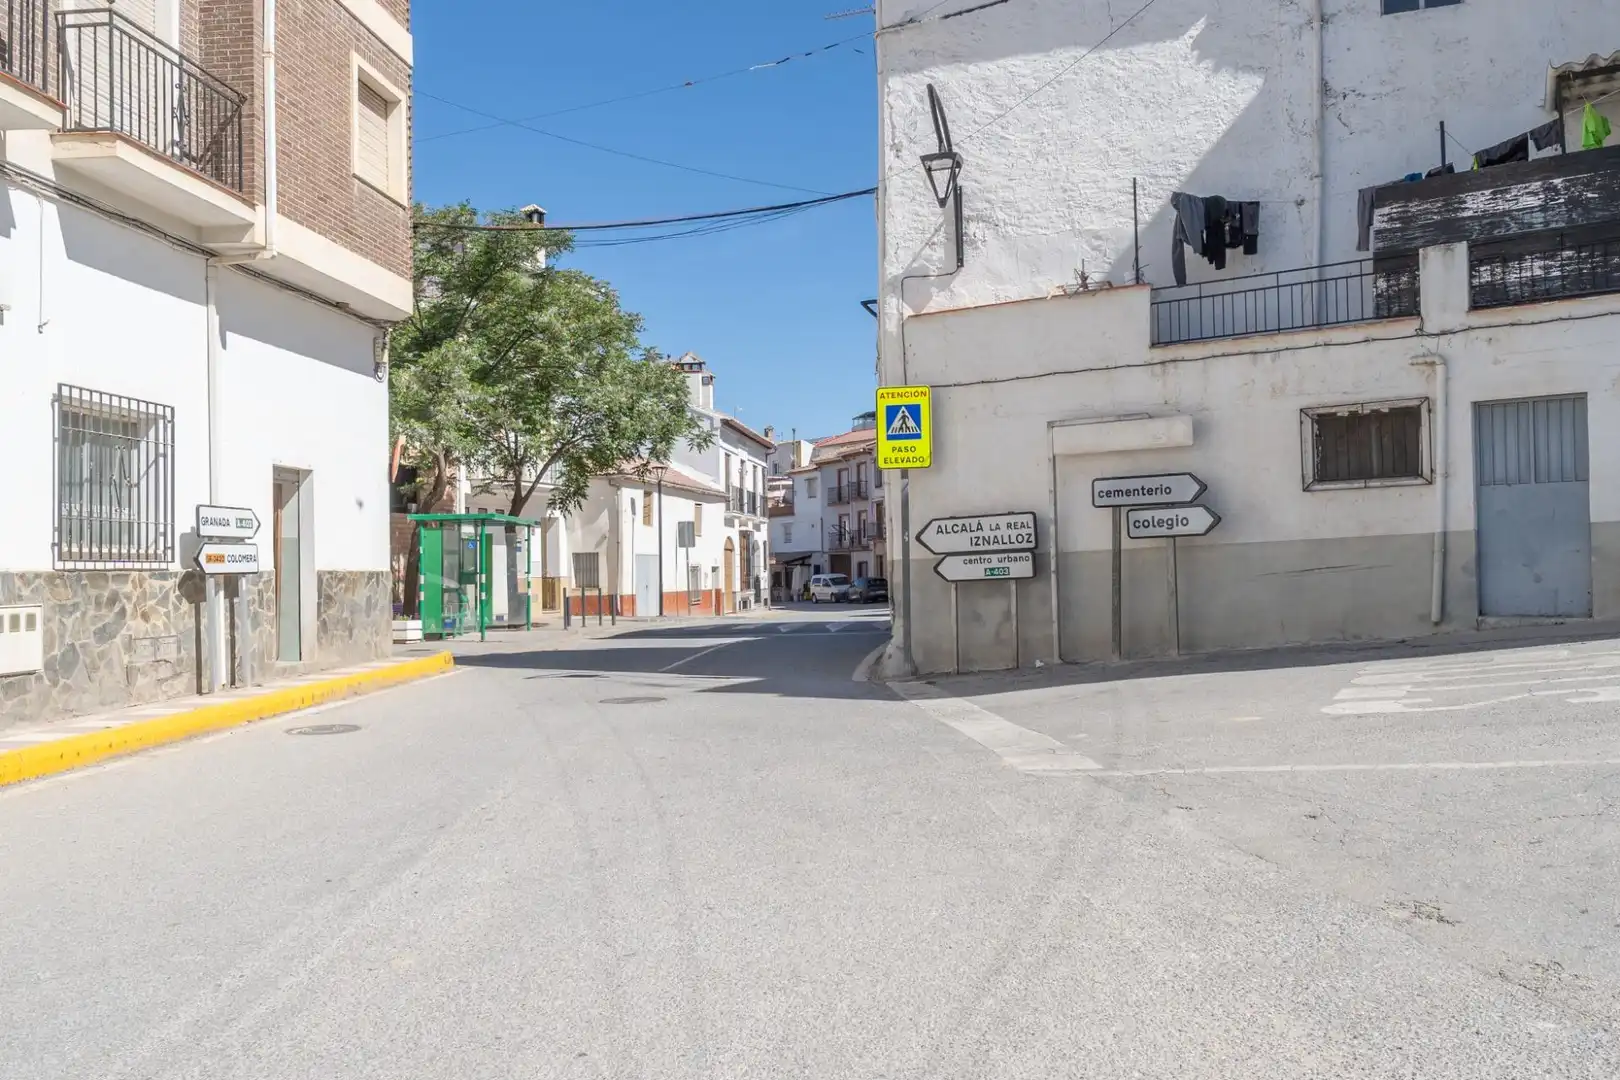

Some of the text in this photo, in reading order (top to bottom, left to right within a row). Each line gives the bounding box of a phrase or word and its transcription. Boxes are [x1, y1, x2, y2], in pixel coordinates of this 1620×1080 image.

[879, 390, 927, 399] ATENCIÓN
[883, 456, 925, 464] ELEVADO
[1097, 484, 1172, 499] cementerio
[201, 516, 231, 527] GRANADA
[1132, 514, 1190, 530] colegio
[936, 520, 1032, 535] ALCALÁ LA REAL
[970, 533, 1033, 546] IZNALLOZ
[227, 554, 257, 563] COLOMERA
[963, 555, 1030, 565] centro urbano
[985, 567, 1010, 576] A-403
